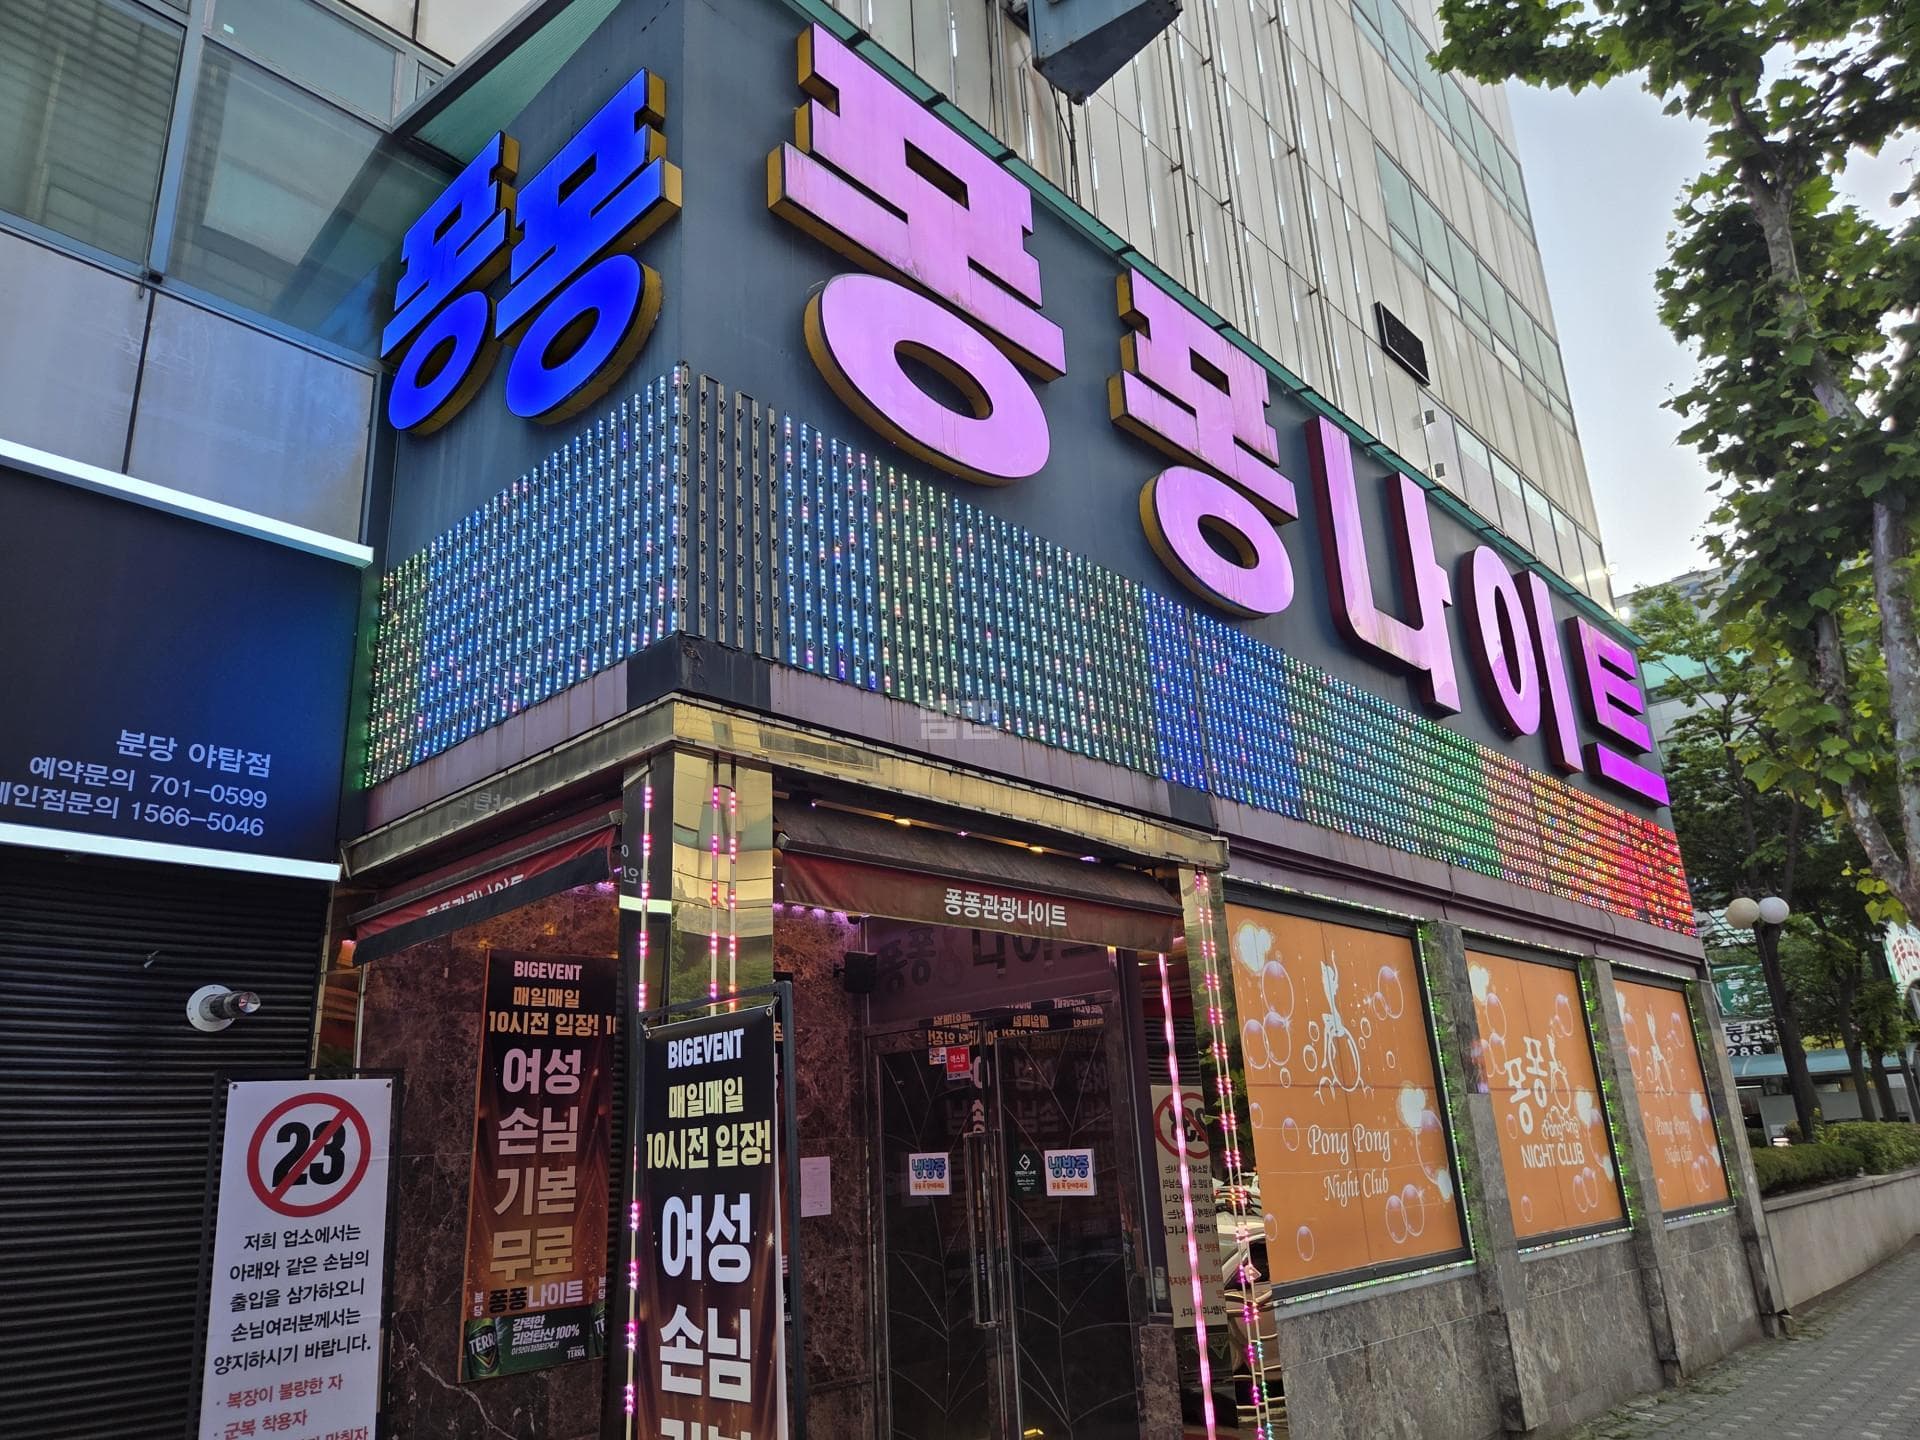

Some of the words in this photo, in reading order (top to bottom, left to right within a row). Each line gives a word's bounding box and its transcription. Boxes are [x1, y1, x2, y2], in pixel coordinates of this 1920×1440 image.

[116, 729, 178, 762] 분당
[188, 743, 272, 778] 야탑점
[29, 756, 136, 792] 예약문의
[150, 775, 268, 809] 701-0599
[131, 801, 265, 837] 1566-5046
[944, 887, 1068, 928] 퐁퐁관광나이트
[513, 960, 583, 981] BIGEVENT
[513, 986, 580, 1009] 매일매일
[489, 1011, 549, 1036] 10시전
[555, 1013, 599, 1037] 입장!
[668, 1028, 744, 1069] BIGEVENT
[502, 1048, 582, 1095] 여성
[668, 1076, 744, 1119] 매일매일
[498, 1106, 579, 1156] 손님
[647, 1126, 709, 1170] 10시전
[715, 1119, 771, 1168] 입장!
[1307, 1123, 1349, 1166] Pong
[1352, 1122, 1391, 1162] Pong
[272, 1121, 346, 1187] 23
[911, 1157, 946, 1179] 냉방중
[1048, 1155, 1089, 1178] 냉방중
[1520, 1146, 1556, 1169] NIGHT
[1557, 1143, 1585, 1167] CLUB
[494, 1166, 577, 1216] 기본
[1323, 1175, 1360, 1208] Night
[1362, 1168, 1389, 1199] Club
[243, 1231, 277, 1252] 저희
[283, 1223, 361, 1248] 업소에서는
[490, 1225, 574, 1283] 무료
[662, 1193, 751, 1283] 여성
[229, 1259, 279, 1282] 아래와
[286, 1255, 318, 1277] 같은
[323, 1249, 369, 1275] 손님의
[230, 1288, 280, 1313] 출입을
[286, 1278, 364, 1307] 삼가하오니
[230, 1307, 361, 1343] 손님여러분께서는
[556, 1324, 580, 1340] 100%
[213, 1345, 298, 1376] 양지하시기
[304, 1333, 371, 1360] 바랍니다.
[659, 1303, 751, 1403] 손님
[226, 1386, 273, 1409] 복장이
[278, 1377, 323, 1401] 불량한
[328, 1374, 343, 1391] 자
[223, 1418, 256, 1440] 군복
[262, 1409, 308, 1433] 착용자
